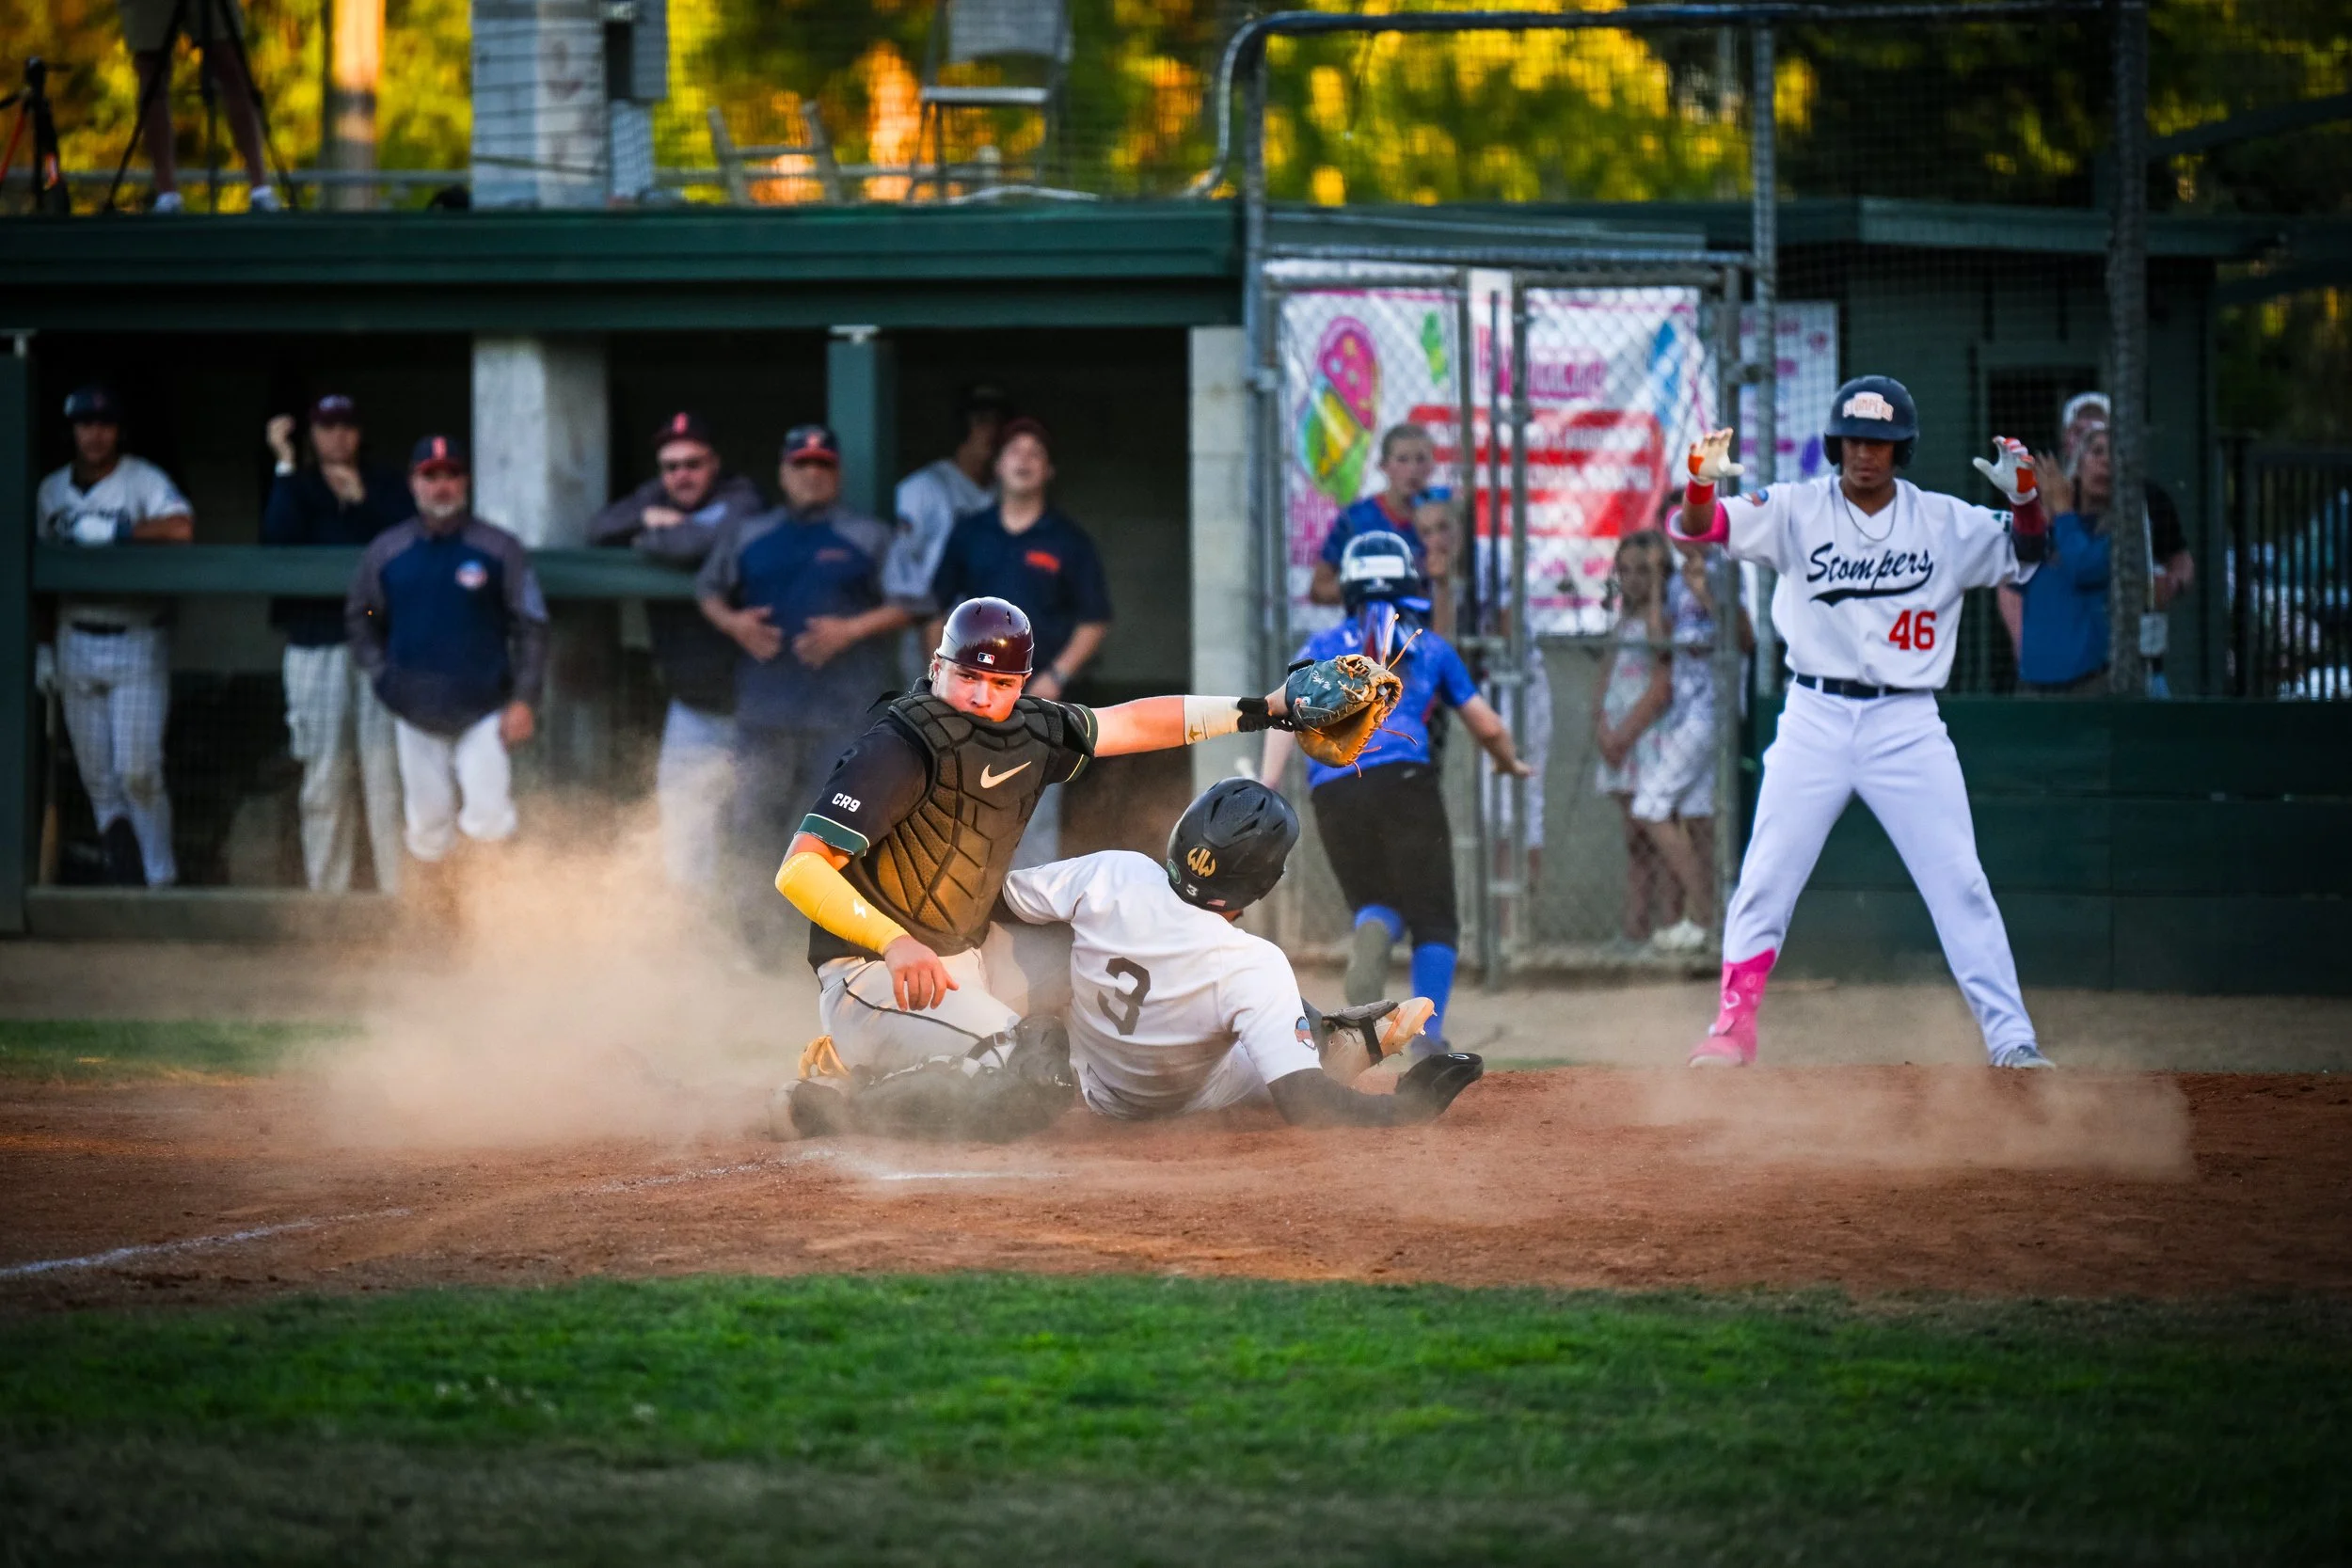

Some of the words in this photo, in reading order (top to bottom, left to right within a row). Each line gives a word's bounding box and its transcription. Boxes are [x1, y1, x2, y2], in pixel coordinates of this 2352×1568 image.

[1807, 542, 1933, 593] Stompers
[1888, 610, 1937, 651] 46
[832, 793, 862, 813] CR9
[1186, 884, 1200, 896] 3
[1097, 957, 1152, 1037] 3
